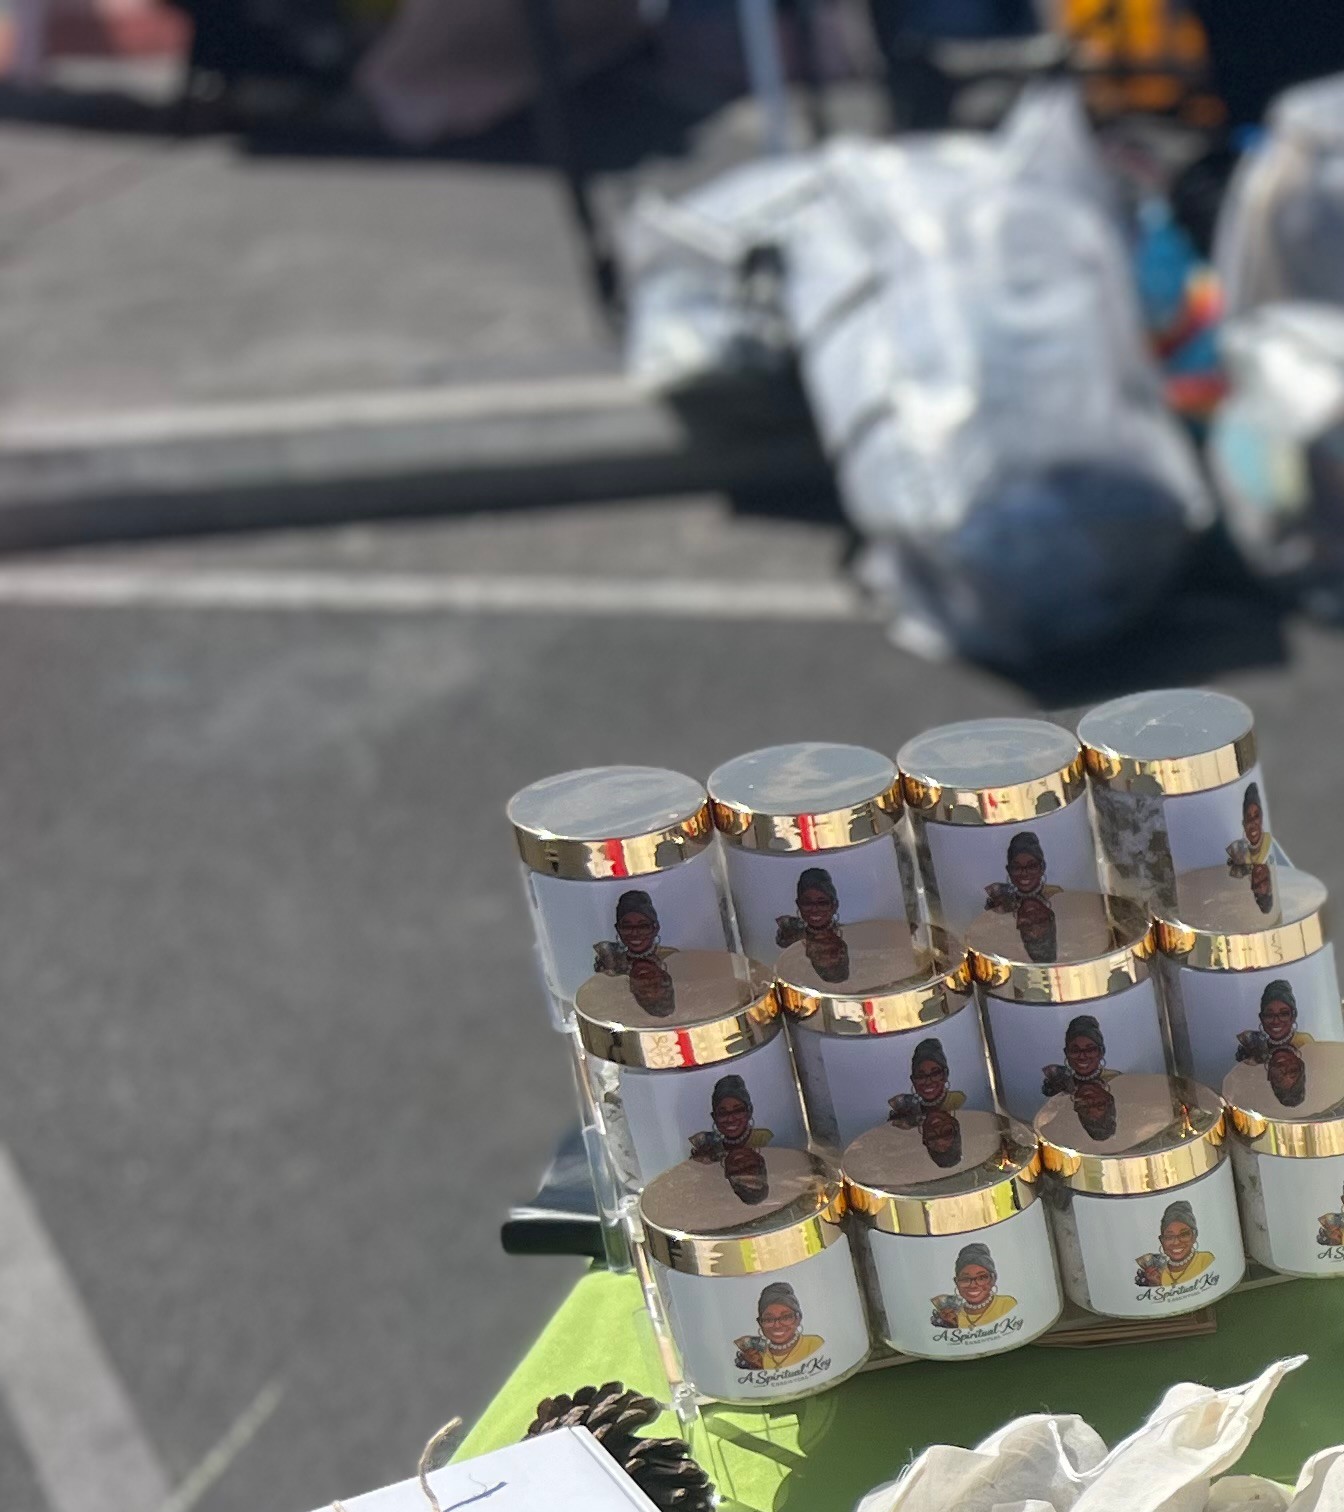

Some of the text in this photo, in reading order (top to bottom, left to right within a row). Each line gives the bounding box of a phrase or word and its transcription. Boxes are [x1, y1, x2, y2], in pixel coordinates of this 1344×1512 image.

[1317, 1246, 1333, 1260] A
[1136, 1270, 1221, 1301] A Spiritual Key
[933, 1315, 1025, 1344] A Spiritual Key
[737, 1355, 832, 1389] A Spiritual Key
